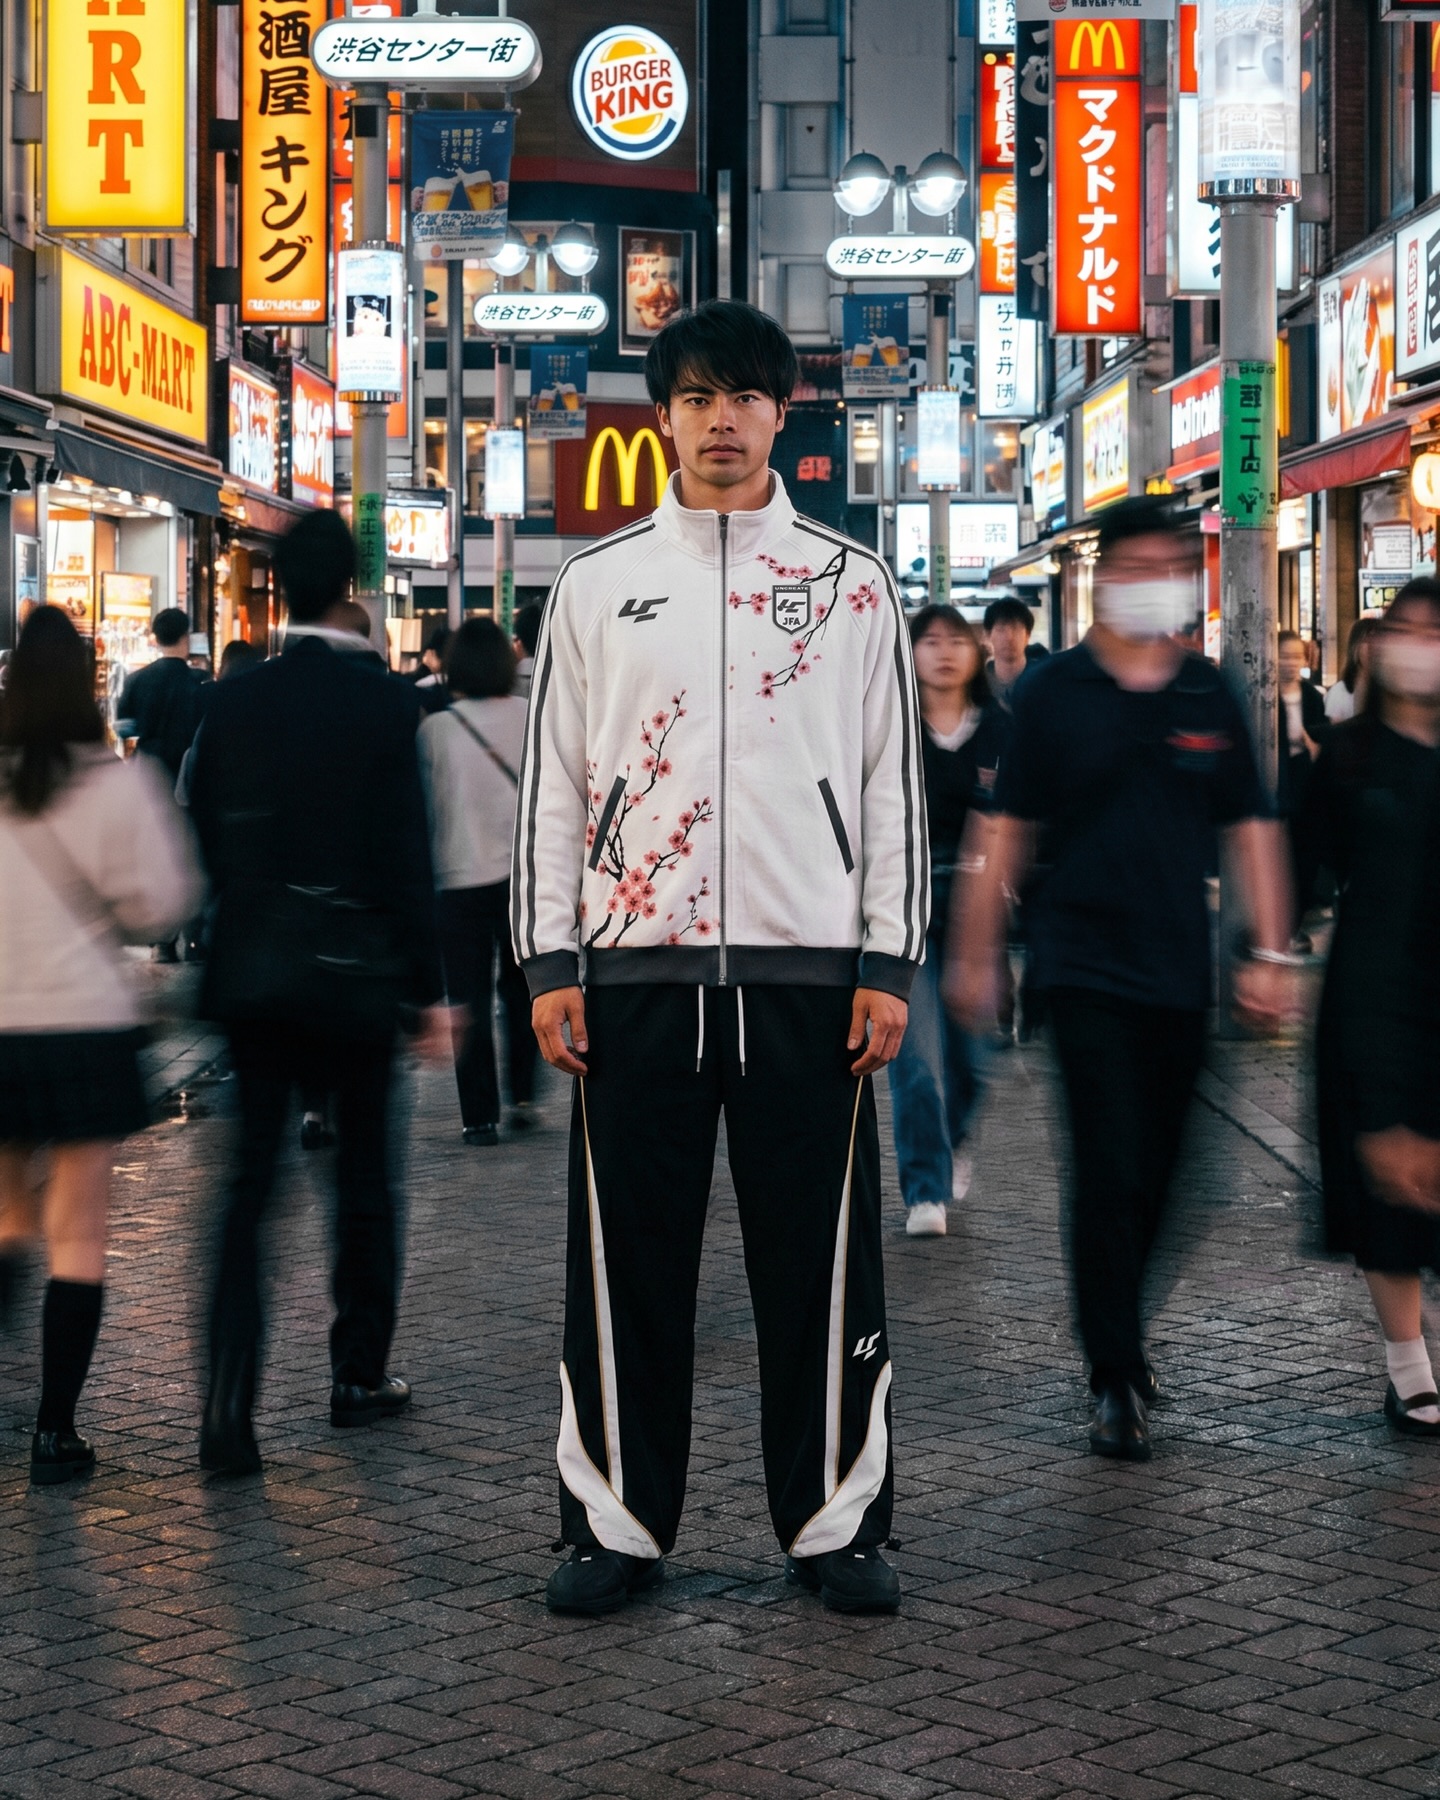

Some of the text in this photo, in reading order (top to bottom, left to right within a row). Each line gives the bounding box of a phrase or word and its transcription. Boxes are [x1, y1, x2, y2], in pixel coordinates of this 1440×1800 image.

[258, 0, 313, 117] 酒屋
[326, 36, 522, 63] 渋谷センター街
[86, 0, 147, 195] RT
[590, 58, 672, 93] BURGER
[595, 80, 674, 125] KING
[258, 135, 314, 284] キング
[1077, 89, 1120, 326] マクドナルド
[834, 247, 967, 265] 渋谷センター街
[480, 305, 598, 321] 渋谷センター街
[79, 284, 196, 415] ABC-MART
[782, 617, 801, 626] JFA
